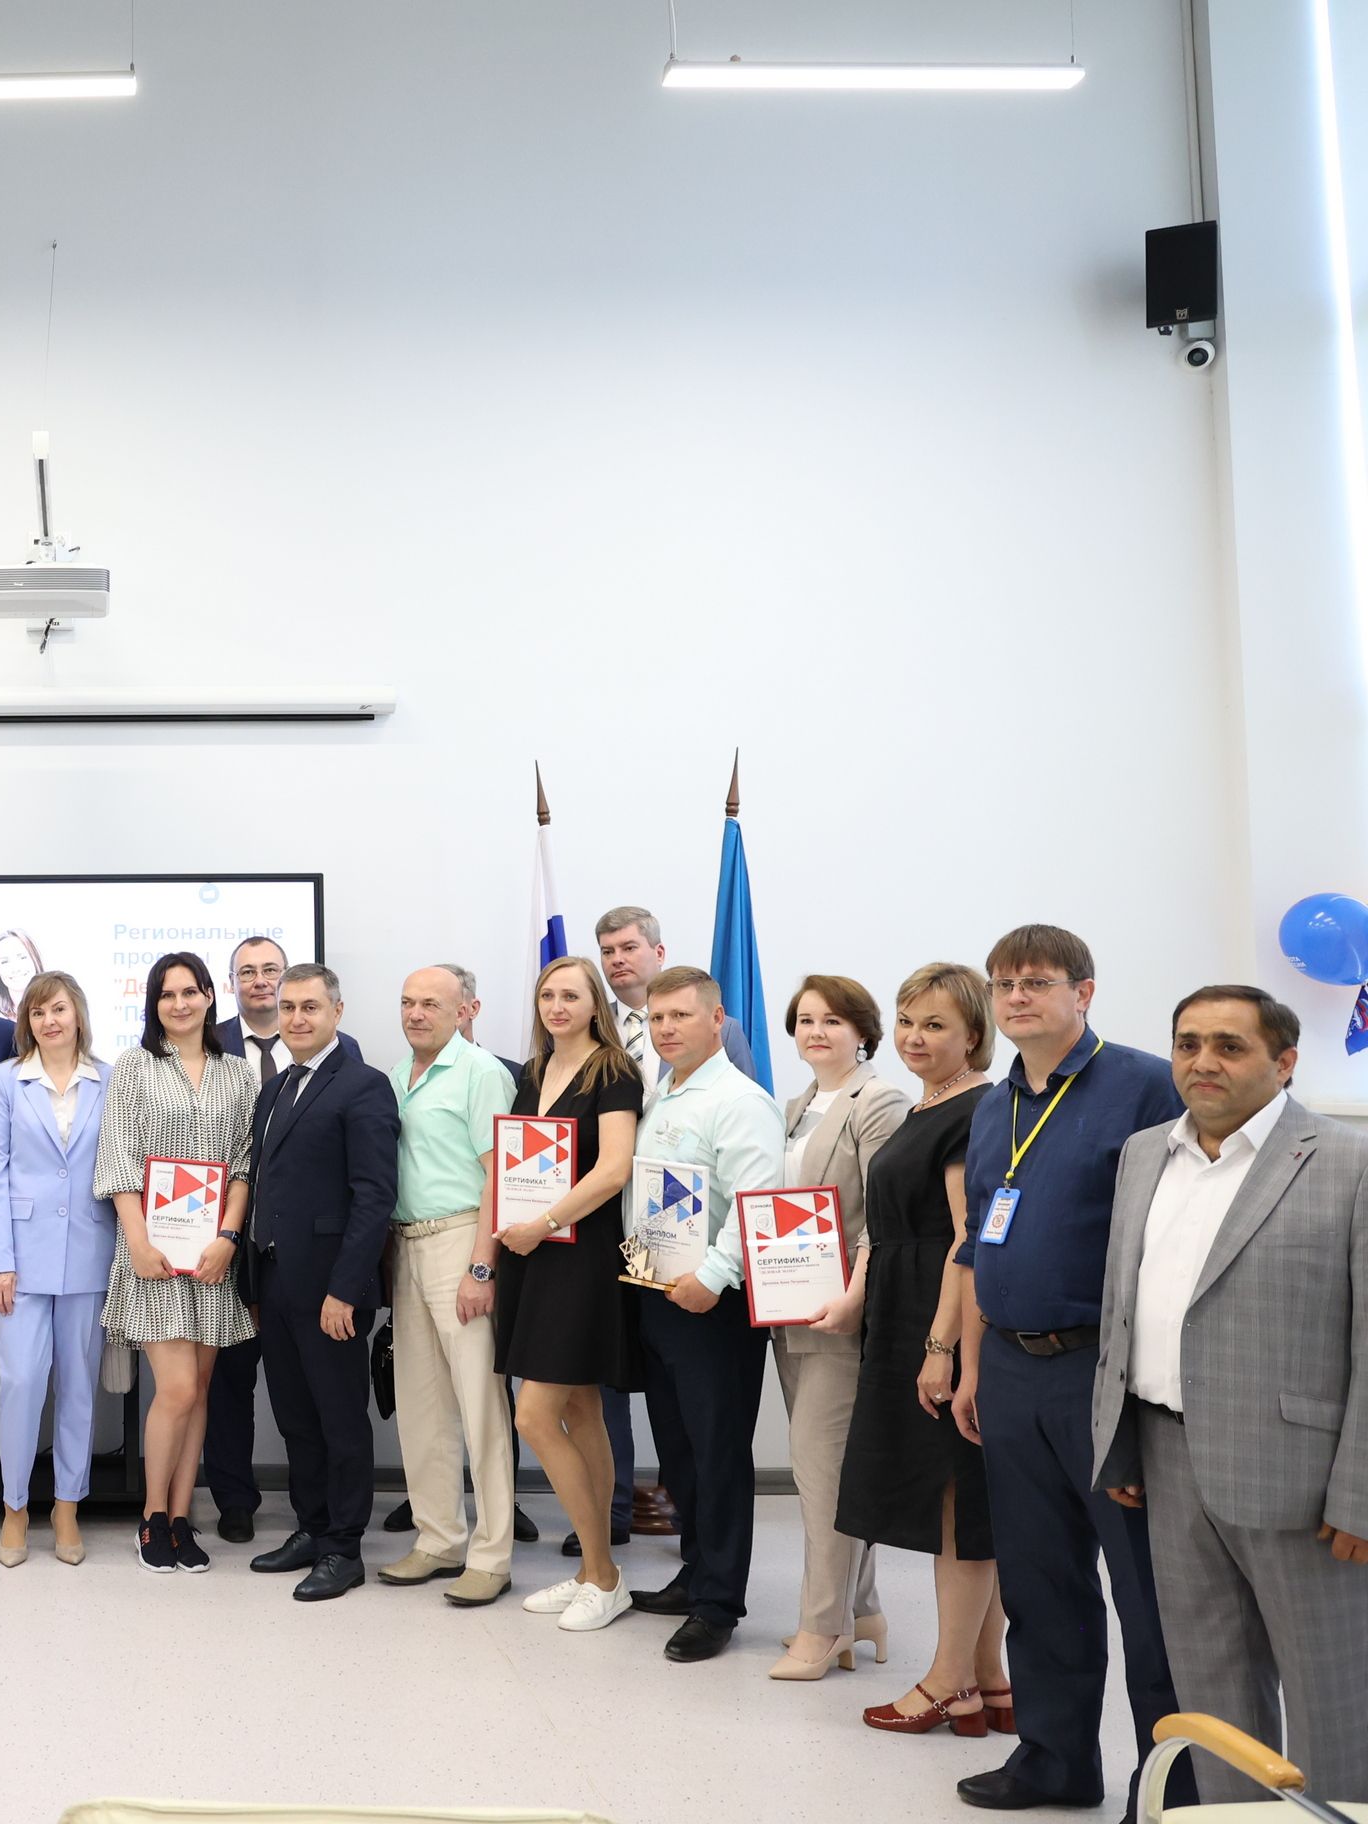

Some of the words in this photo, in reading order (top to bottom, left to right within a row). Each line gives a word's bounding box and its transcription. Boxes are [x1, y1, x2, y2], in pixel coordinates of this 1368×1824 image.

[113, 924, 284, 941] Региональные
[504, 1176, 547, 1185] СЕРТИФИКАТ
[152, 1215, 194, 1224] СЕРТИФИКАТ
[646, 1228, 677, 1239] ДИПЛОМ
[757, 1256, 810, 1266] СЕРТИФИКАТ
